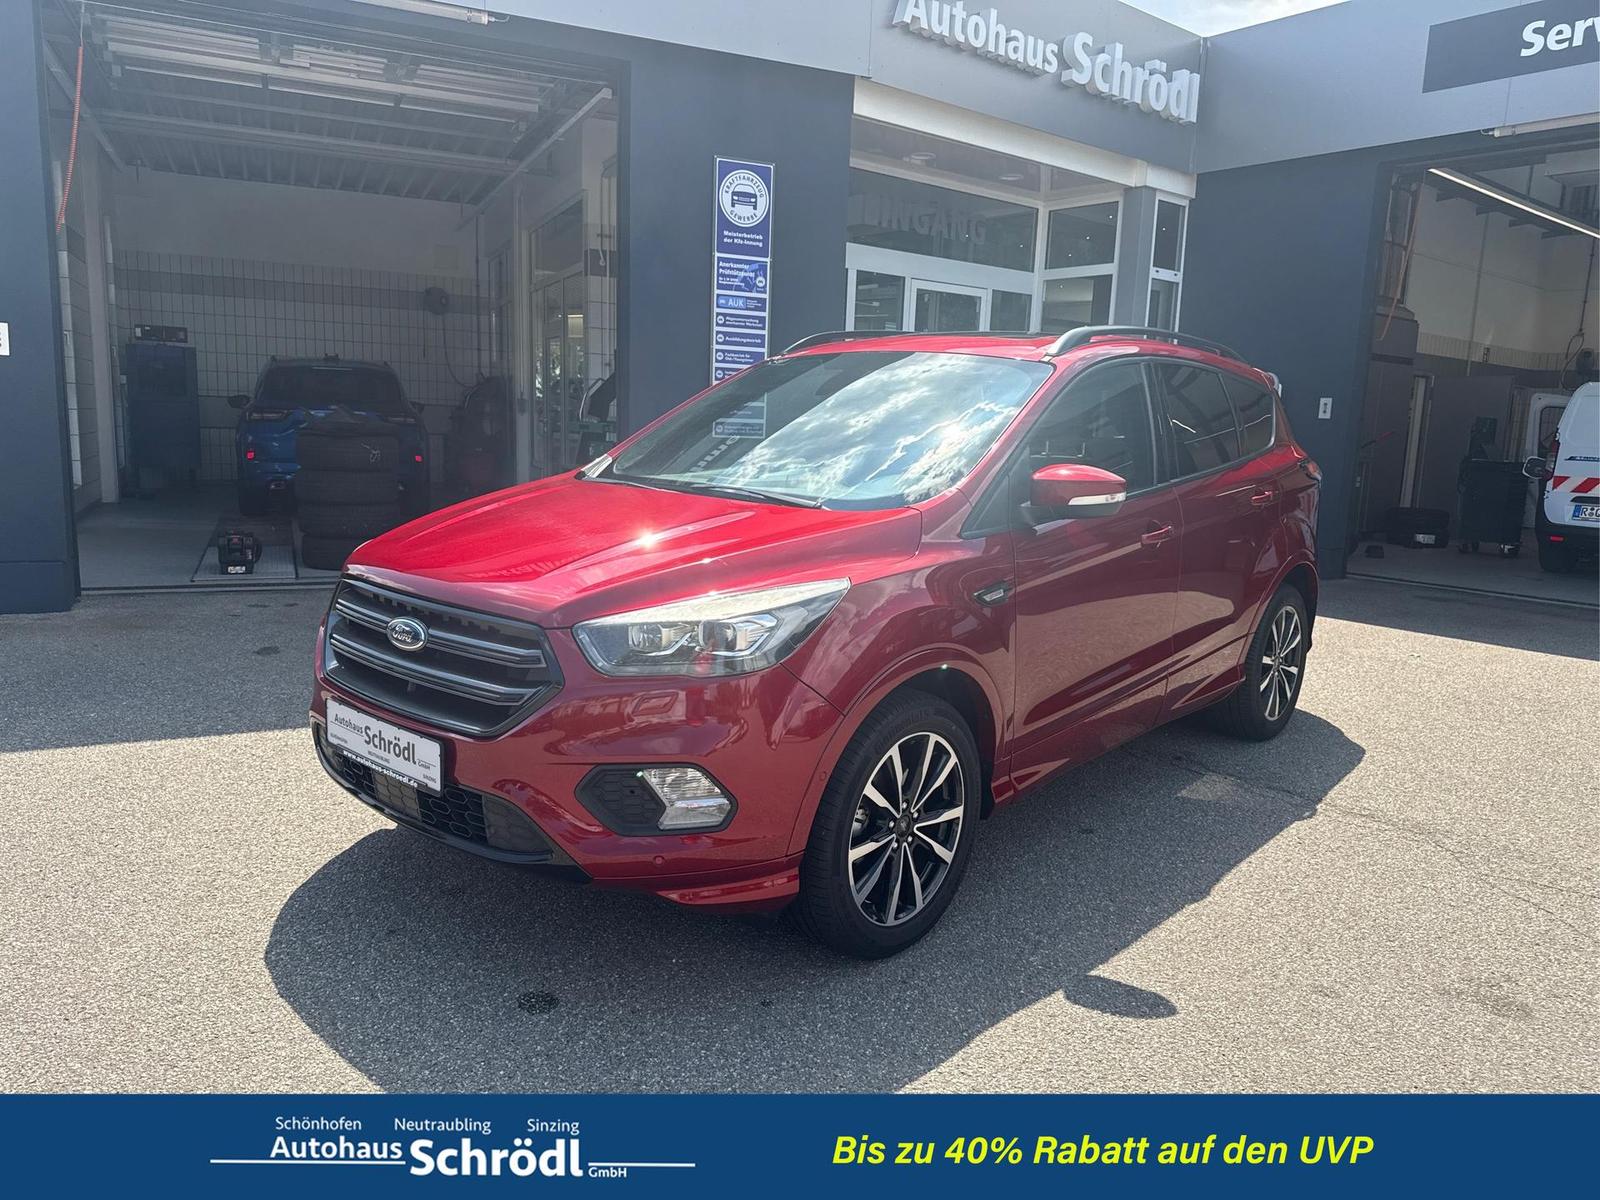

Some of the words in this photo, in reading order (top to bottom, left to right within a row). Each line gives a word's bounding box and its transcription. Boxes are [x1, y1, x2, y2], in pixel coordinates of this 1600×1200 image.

[892, 0, 1059, 74] Autohaus
[1061, 32, 1201, 124] Schrödl
[728, 298, 744, 308] AUK
[334, 713, 364, 734] Autohaus
[364, 725, 417, 765] Schrödl
